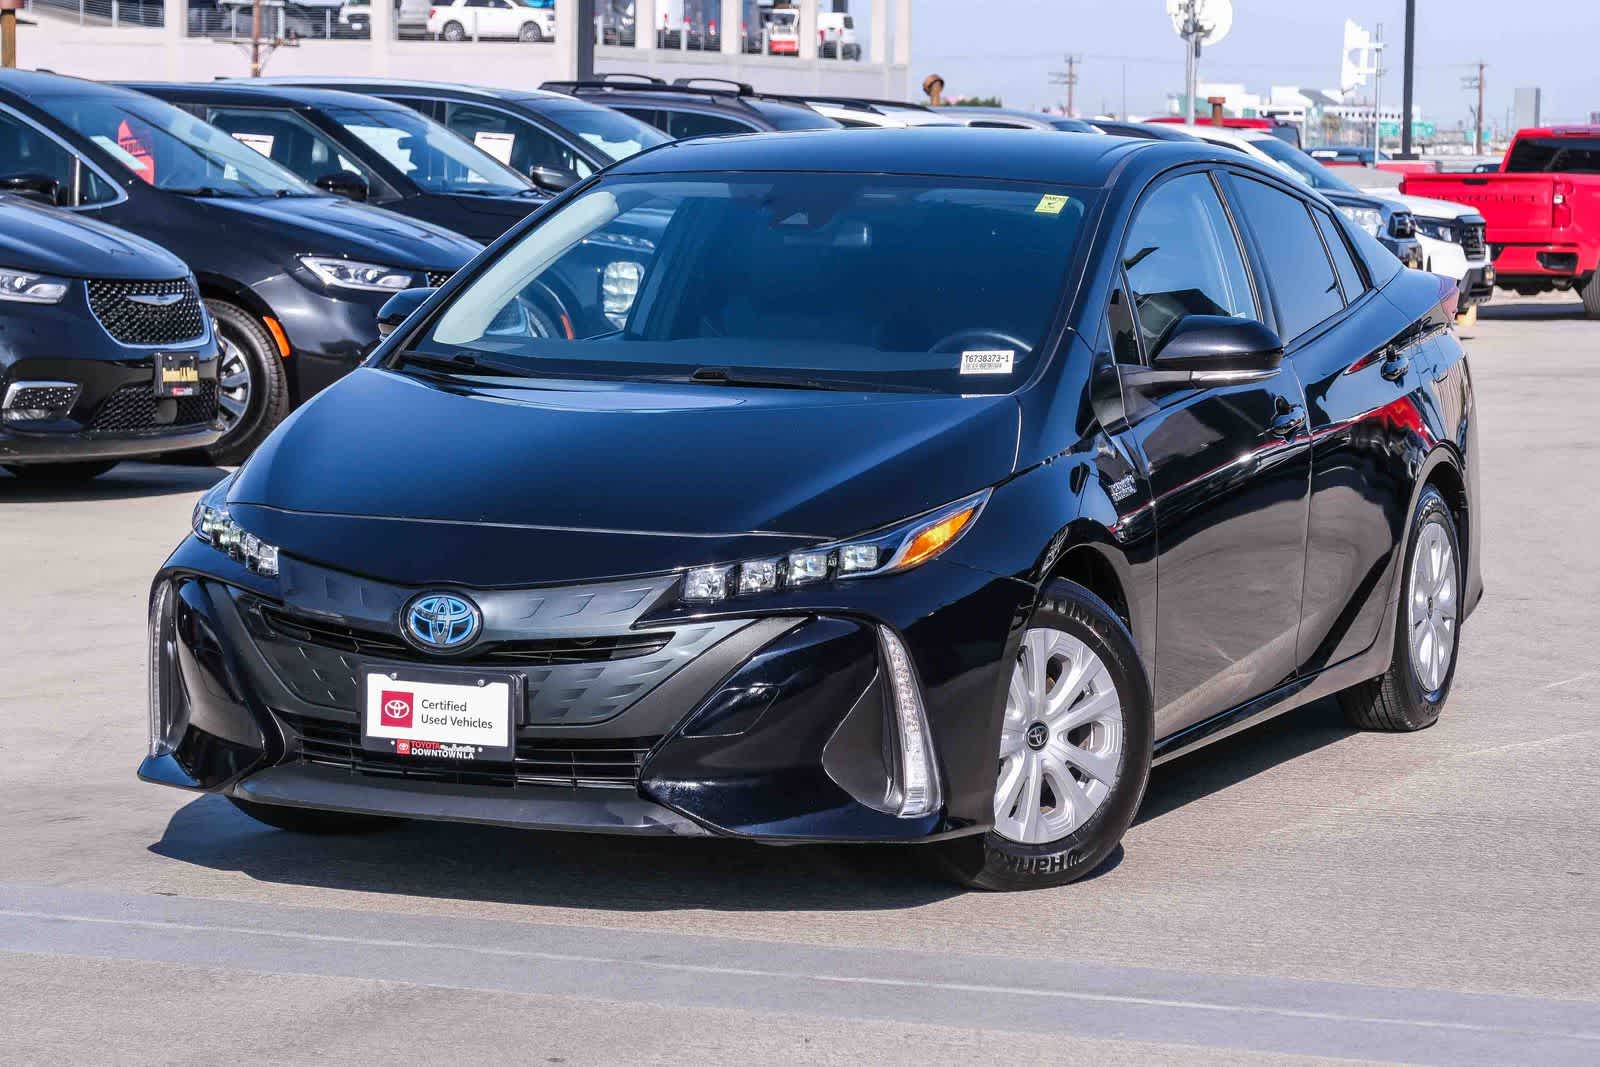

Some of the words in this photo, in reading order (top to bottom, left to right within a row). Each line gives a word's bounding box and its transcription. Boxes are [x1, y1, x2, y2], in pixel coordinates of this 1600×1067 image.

[421, 699, 468, 712] Certified
[421, 714, 448, 726] Used
[450, 716, 494, 729] Vehicles
[411, 741, 441, 750] TOYOTA
